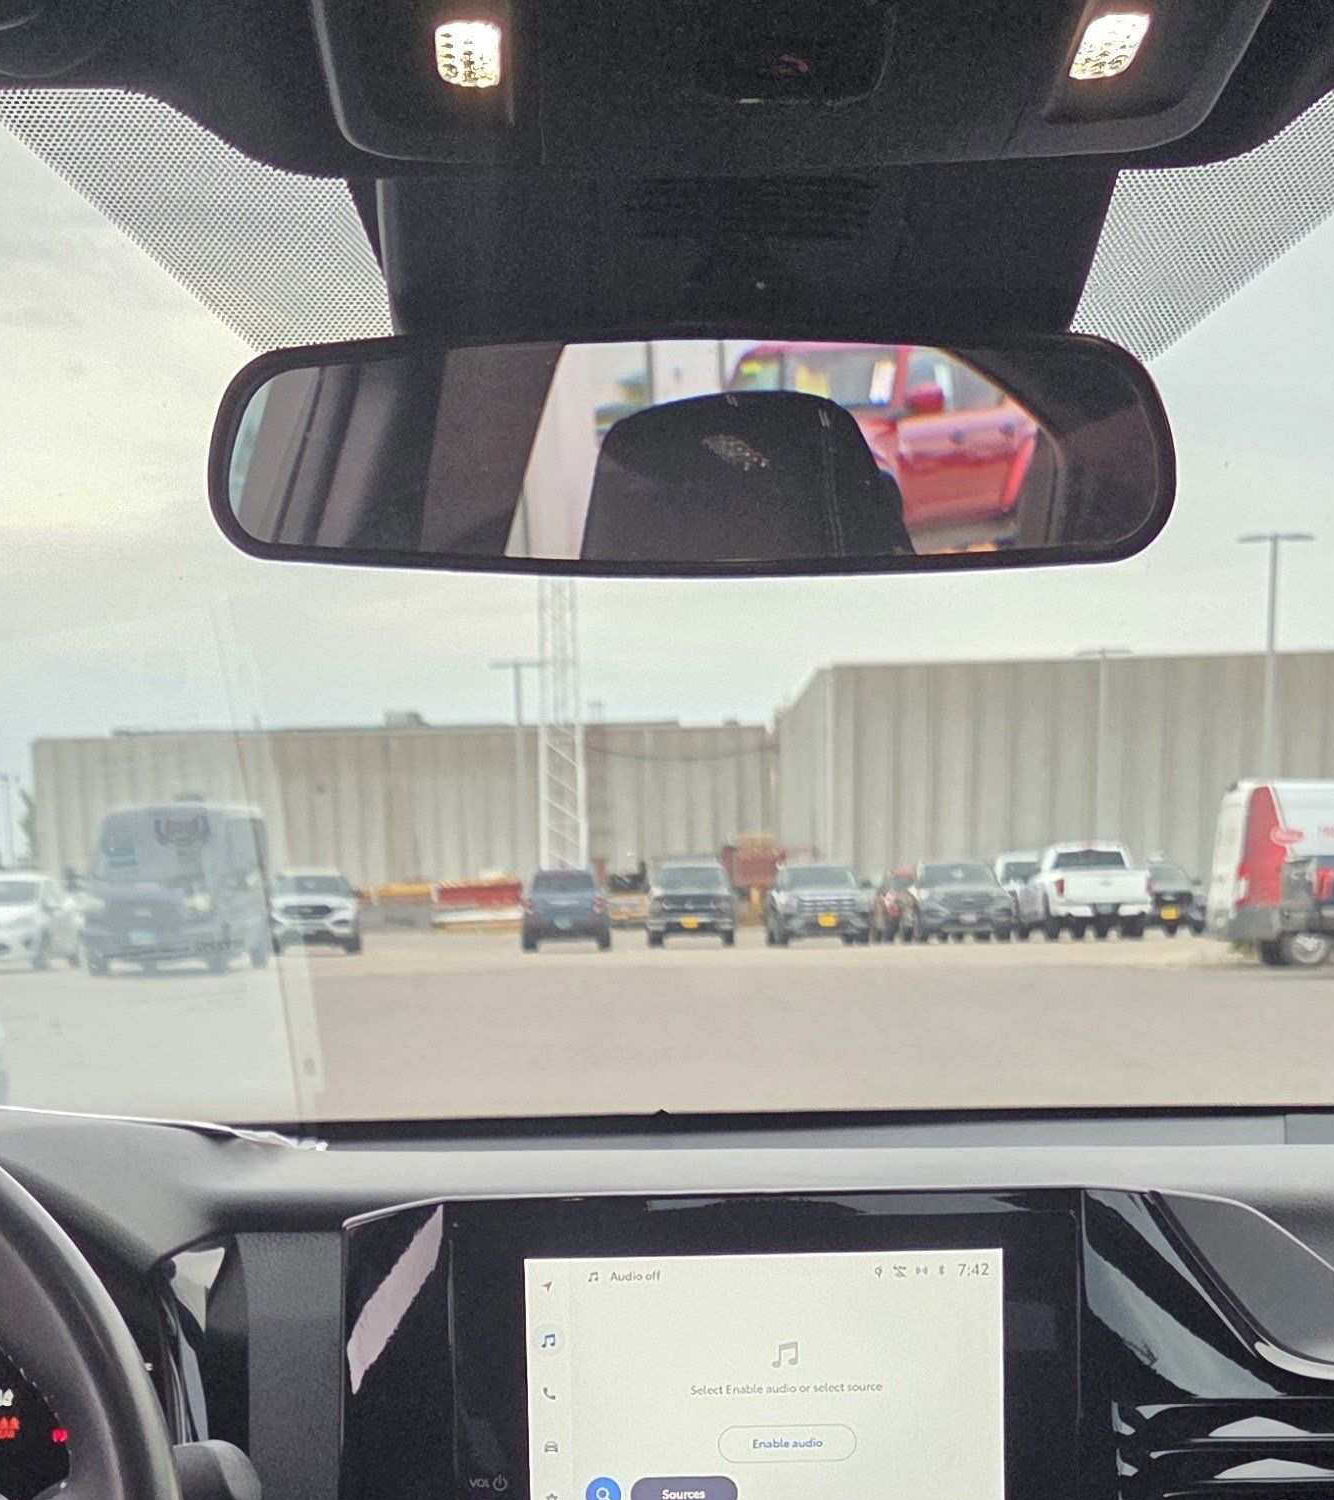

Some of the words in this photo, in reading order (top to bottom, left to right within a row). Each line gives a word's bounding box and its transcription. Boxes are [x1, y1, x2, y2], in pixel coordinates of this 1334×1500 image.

[609, 1270, 645, 1283] Audio
[645, 1270, 661, 1283] off
[958, 1263, 990, 1278] 7:42
[690, 1383, 724, 1396] Select
[725, 1383, 764, 1395] Enable
[765, 1383, 797, 1395] audio
[798, 1384, 811, 1394] or
[813, 1381, 845, 1394] select
[847, 1382, 883, 1393] source
[752, 1437, 790, 1450] Enable
[791, 1437, 823, 1449] audio
[469, 1477, 490, 1489] VOL
[661, 1488, 706, 1500] Sources
